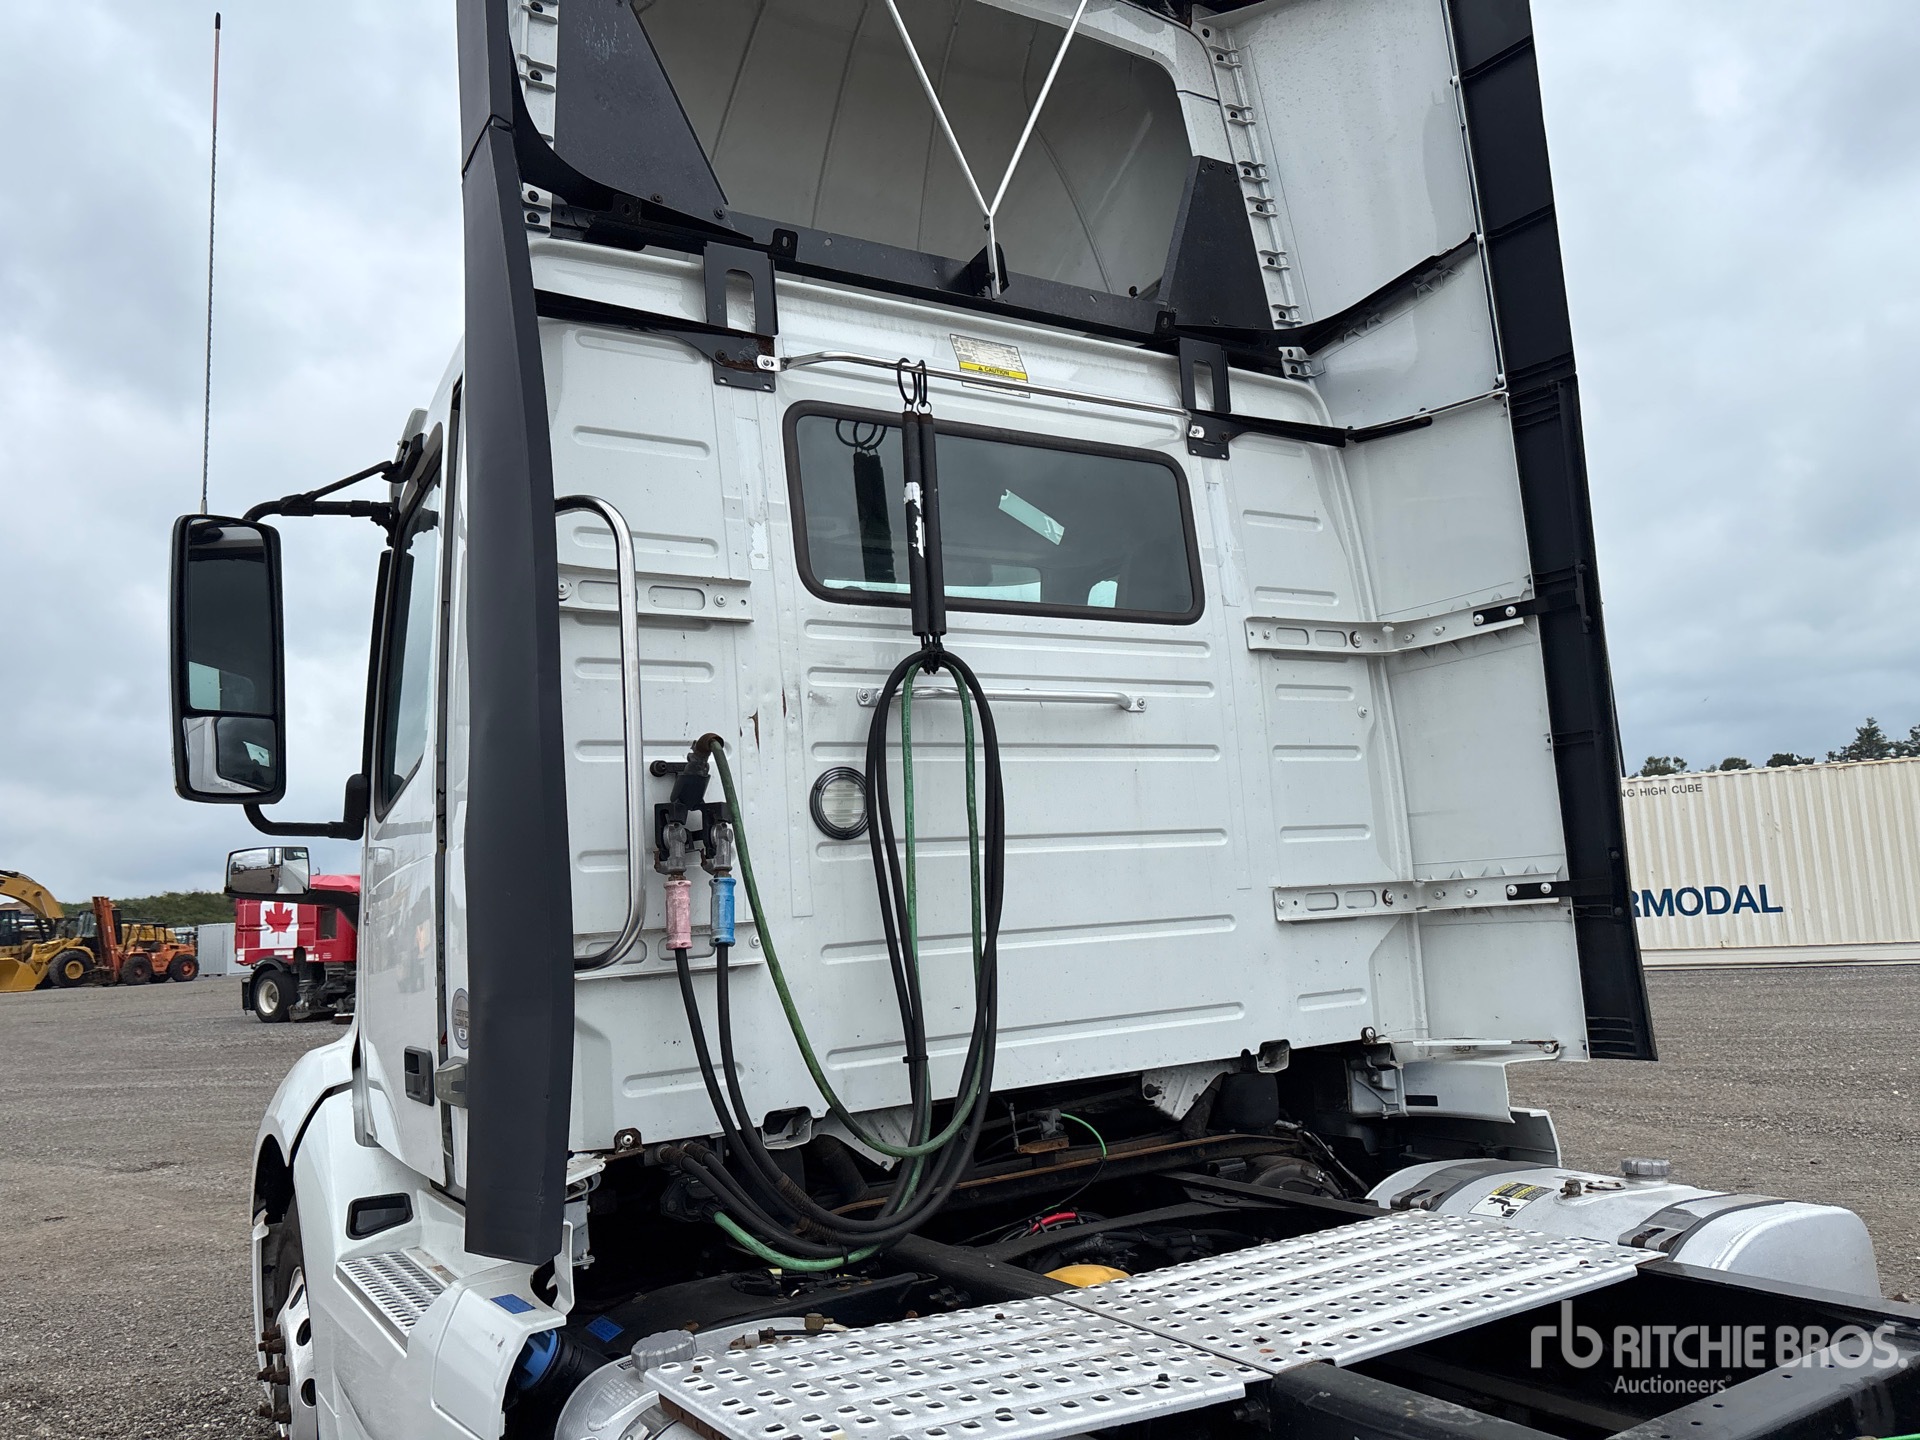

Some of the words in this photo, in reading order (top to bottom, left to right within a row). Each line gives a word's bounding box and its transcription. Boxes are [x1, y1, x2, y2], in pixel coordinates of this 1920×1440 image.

[984, 366, 1010, 376] CAUTION
[1639, 786, 1667, 797] HIGH
[1671, 783, 1703, 794] CUBE
